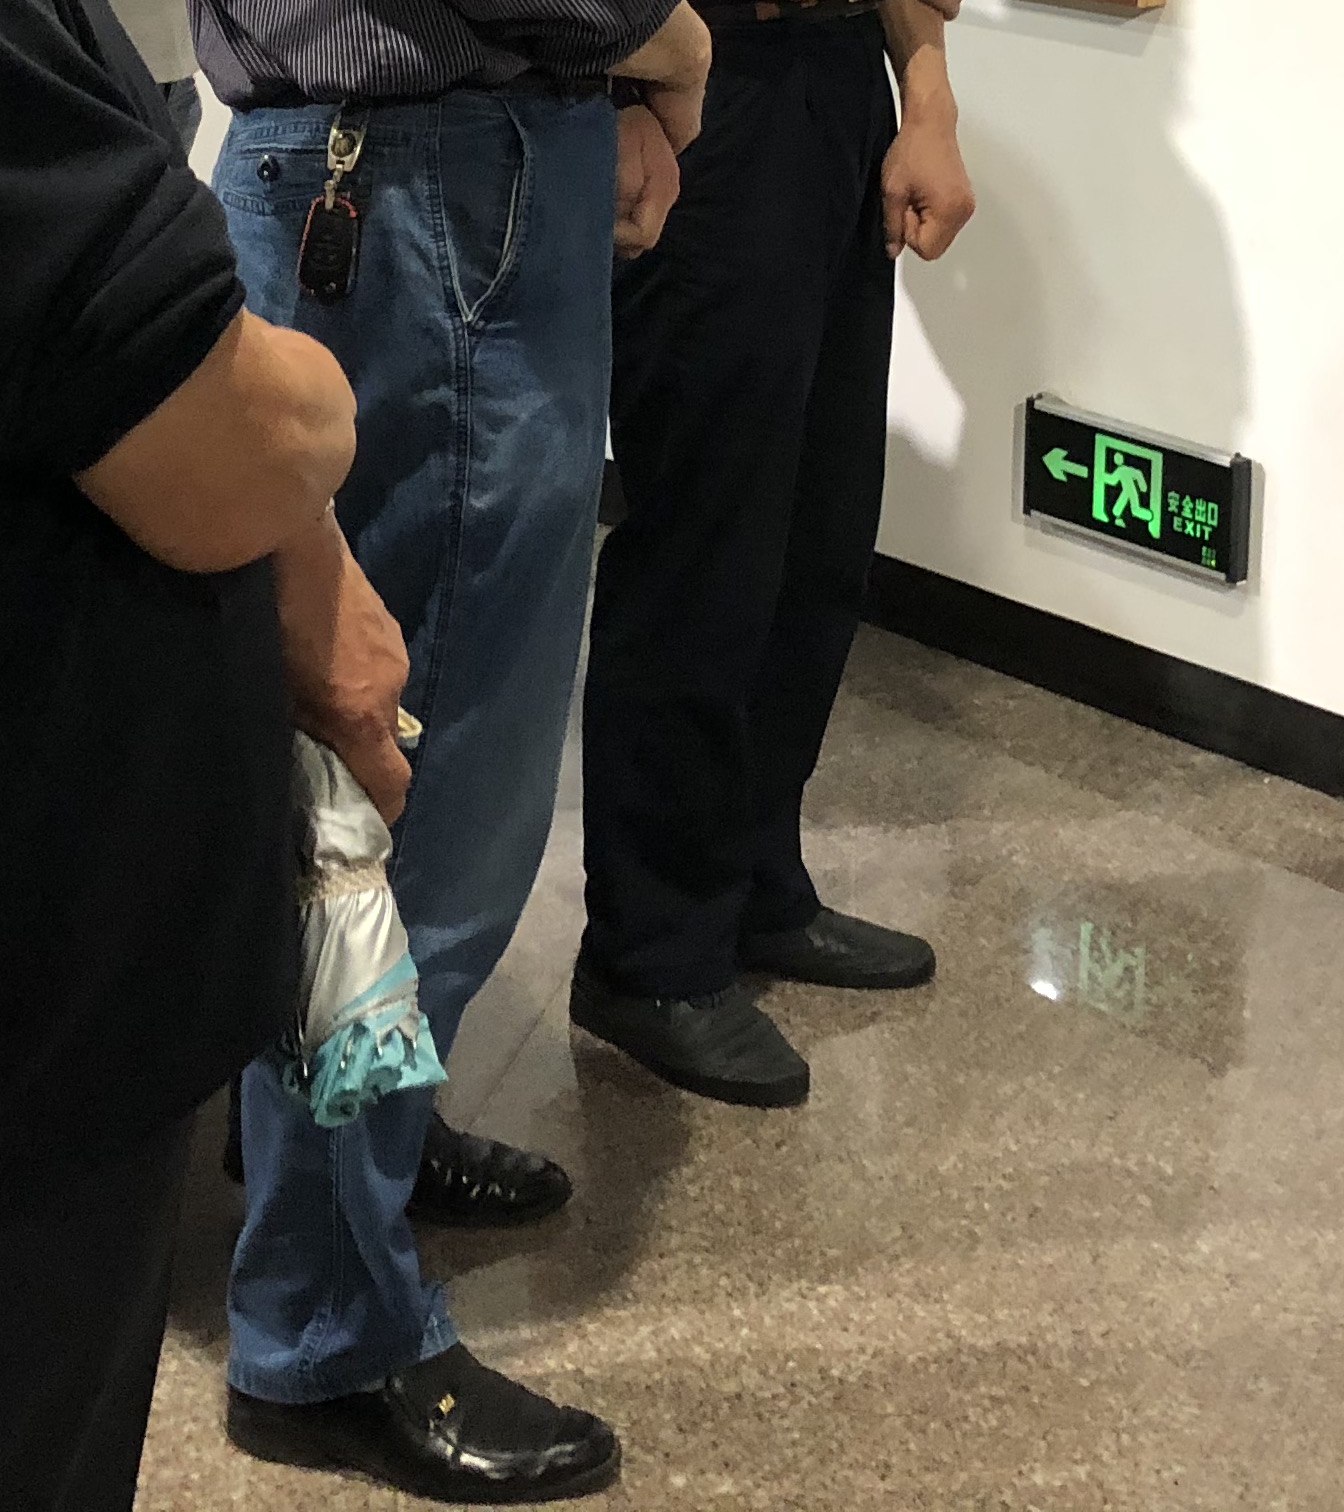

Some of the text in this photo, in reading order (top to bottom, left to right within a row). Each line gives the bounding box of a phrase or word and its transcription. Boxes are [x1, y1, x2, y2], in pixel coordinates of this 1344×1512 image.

[1167, 491, 1219, 527] 安全出口
[1173, 516, 1212, 541] EXIT
